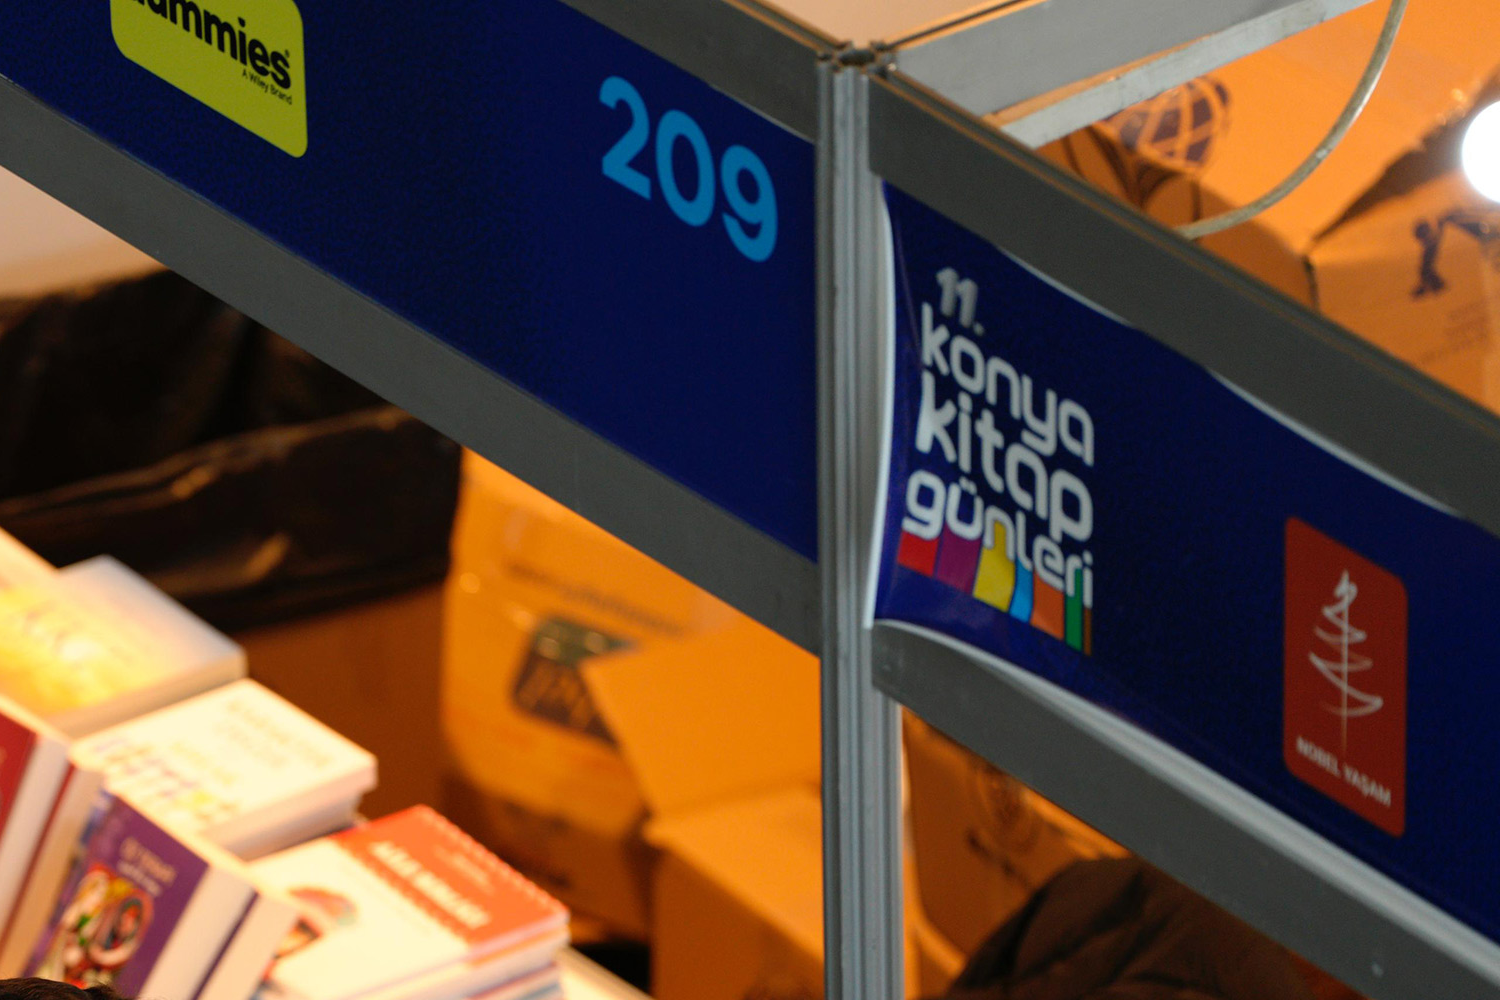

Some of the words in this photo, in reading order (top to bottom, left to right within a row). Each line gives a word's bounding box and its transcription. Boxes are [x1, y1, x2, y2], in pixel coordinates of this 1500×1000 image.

[132, 0, 291, 90] ummies
[249, 72, 269, 93] Wiley
[270, 84, 292, 106] Brand
[599, 75, 778, 263] 209
[921, 302, 1094, 467] konya
[915, 370, 1094, 543] kitap
[901, 469, 1094, 609] günleri
[1296, 735, 1340, 779] NOBEL
